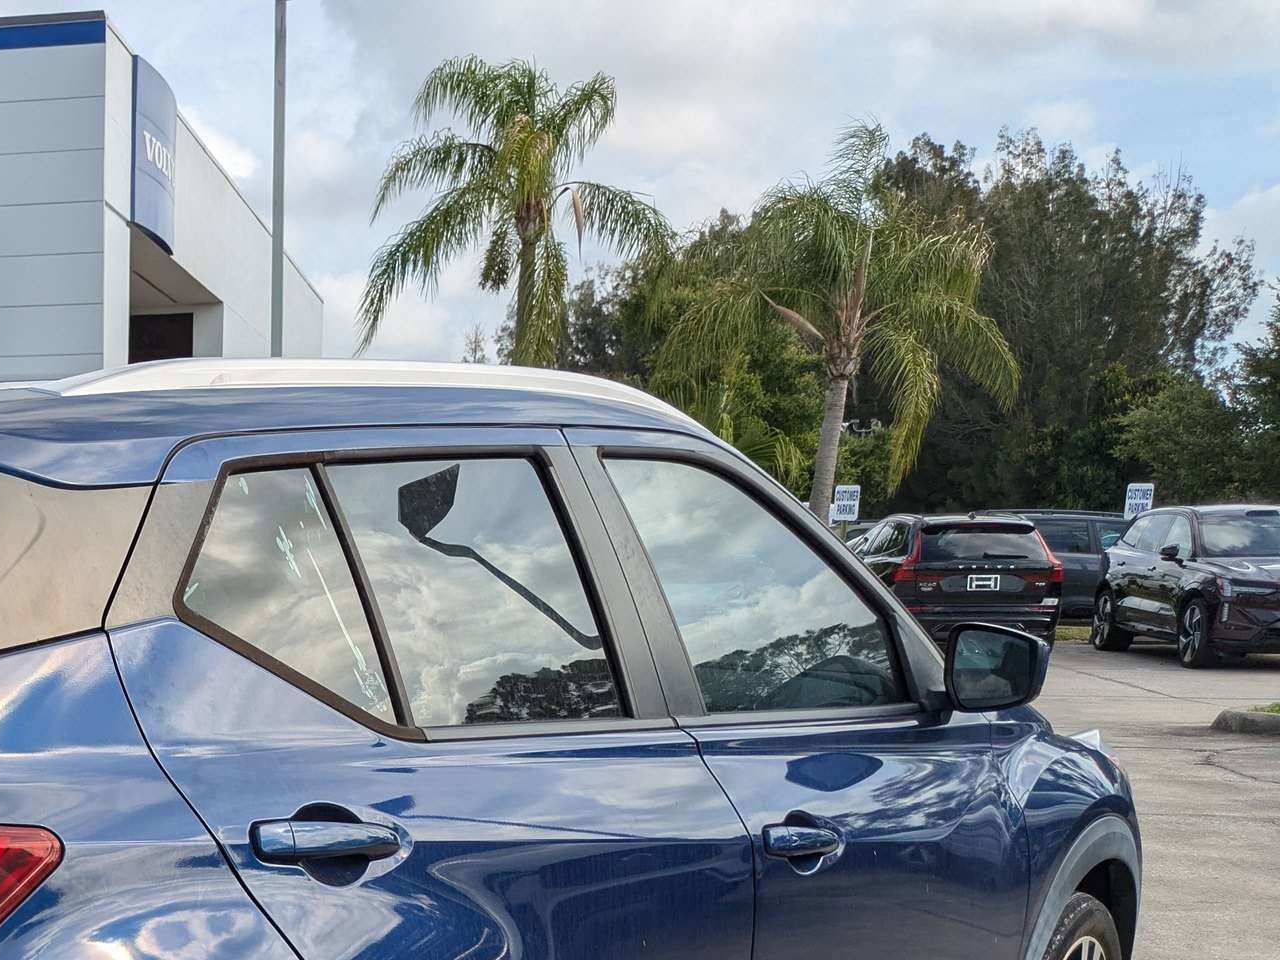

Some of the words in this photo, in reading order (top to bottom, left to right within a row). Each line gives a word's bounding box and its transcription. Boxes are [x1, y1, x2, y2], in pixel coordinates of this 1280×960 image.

[835, 490, 859, 501] CUSTOMER
[1128, 489, 1152, 500] CUSTOMER
[836, 503, 856, 515] PARKING
